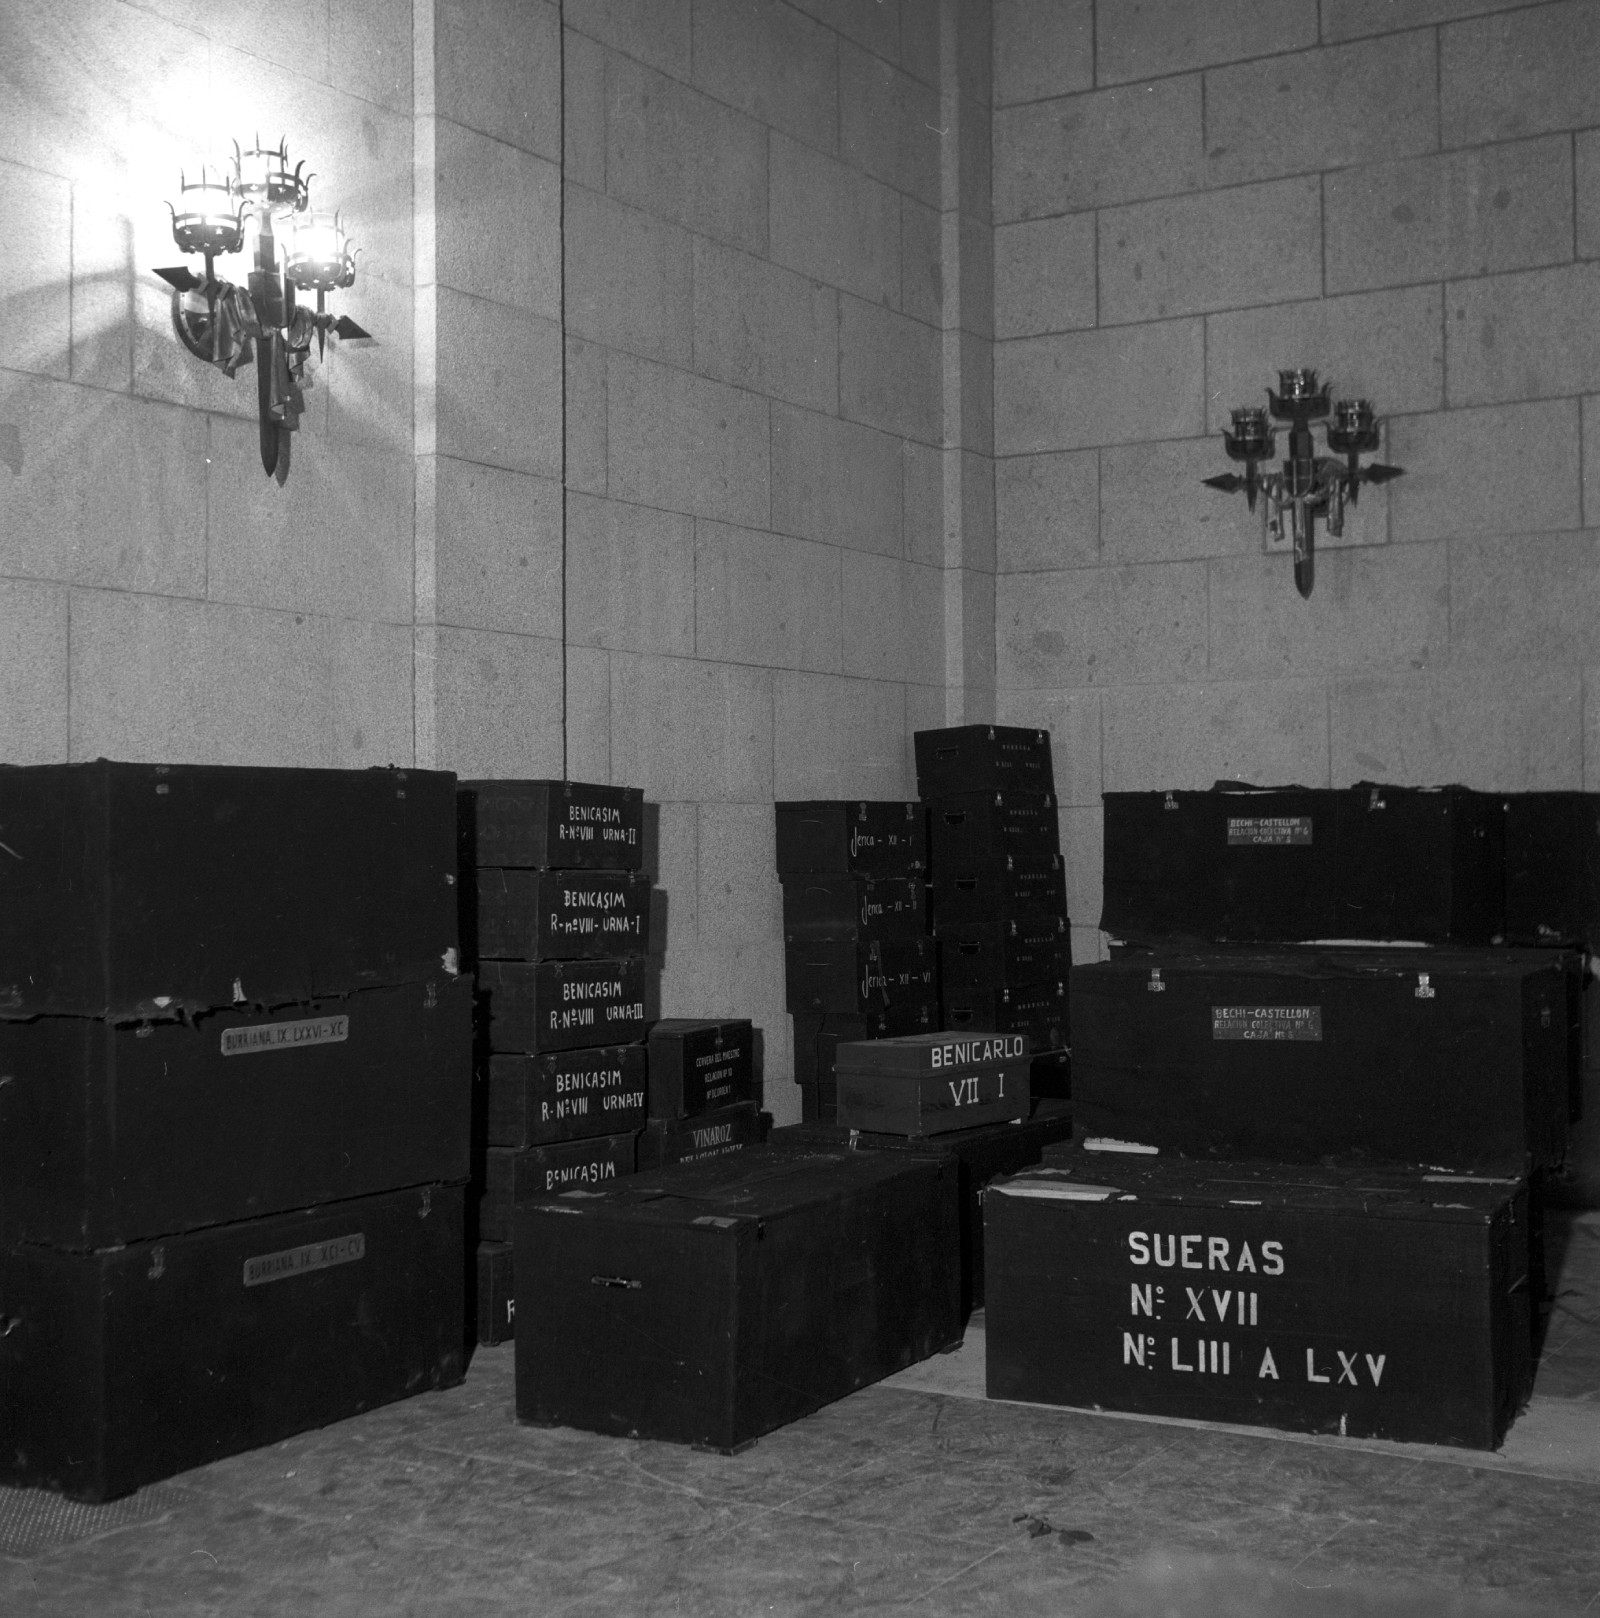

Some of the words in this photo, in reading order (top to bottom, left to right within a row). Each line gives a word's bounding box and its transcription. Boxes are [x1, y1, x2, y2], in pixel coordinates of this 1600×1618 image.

[569, 805, 621, 825] BENICASIM
[563, 890, 626, 910] BENICASIM
[563, 981, 622, 1001] BENICASIM
[931, 1036, 1023, 1068] BENICARLO
[556, 1070, 622, 1093] BENICASIM
[949, 1077, 979, 1107] VII
[998, 1073, 1004, 1098] I
[693, 1123, 732, 1148] VINAROZ
[1127, 1230, 1284, 1276] SUERAS
[1185, 1286, 1257, 1326] XVII
[1171, 1336, 1230, 1376] LIII
[1258, 1346, 1280, 1380] A
[1306, 1347, 1386, 1388] LXV
